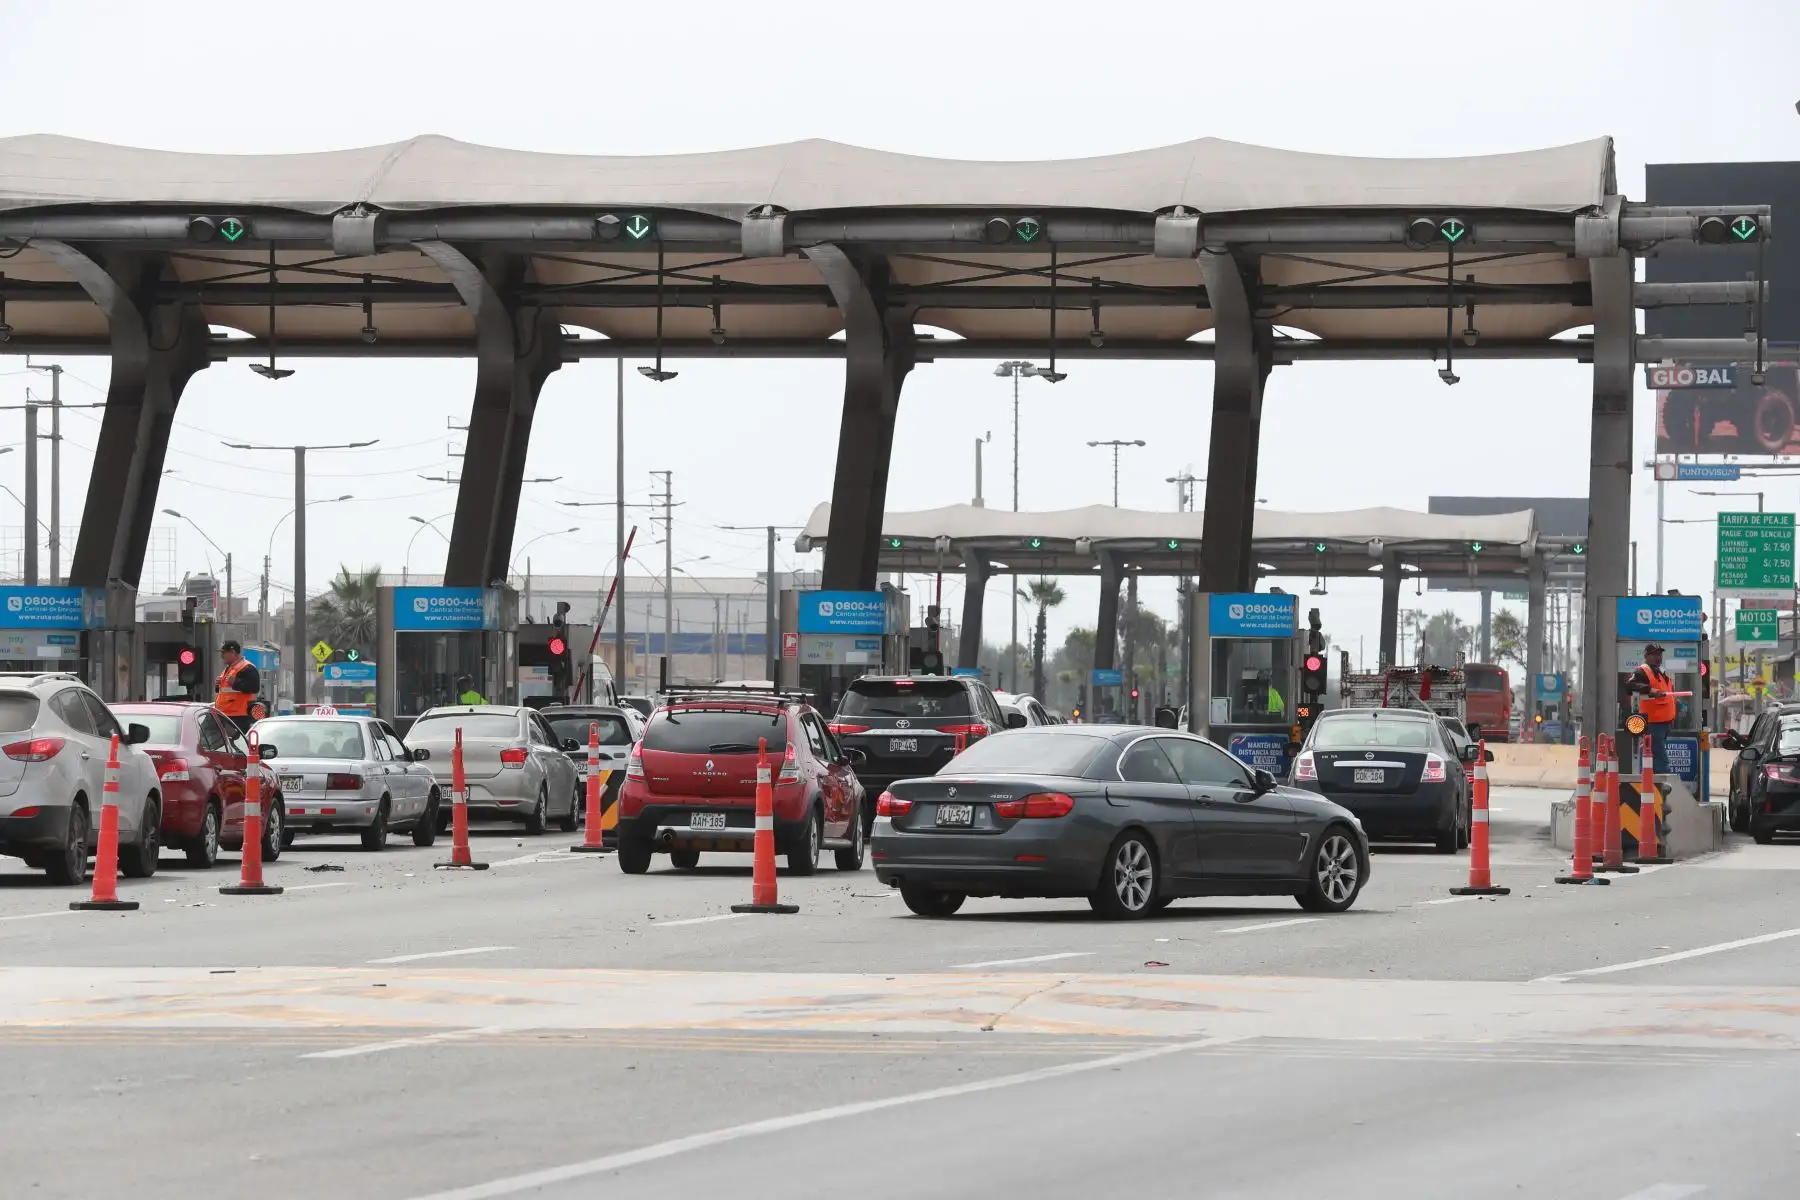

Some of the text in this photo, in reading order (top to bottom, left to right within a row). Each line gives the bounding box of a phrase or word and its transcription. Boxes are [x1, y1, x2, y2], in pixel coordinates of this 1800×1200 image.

[1653, 369, 1731, 386] GLOBAL
[1722, 515, 1788, 525] TARIFA DE PEAJE
[1774, 543, 1790, 552] 7.50
[1774, 559, 1790, 568] 7.50
[1773, 575, 1790, 584] 7.50
[1740, 612, 1773, 622] MOTOS
[316, 708, 334, 716] TAXI
[936, 808, 971, 821] ALV-521
[692, 817, 724, 828] AAM-185
